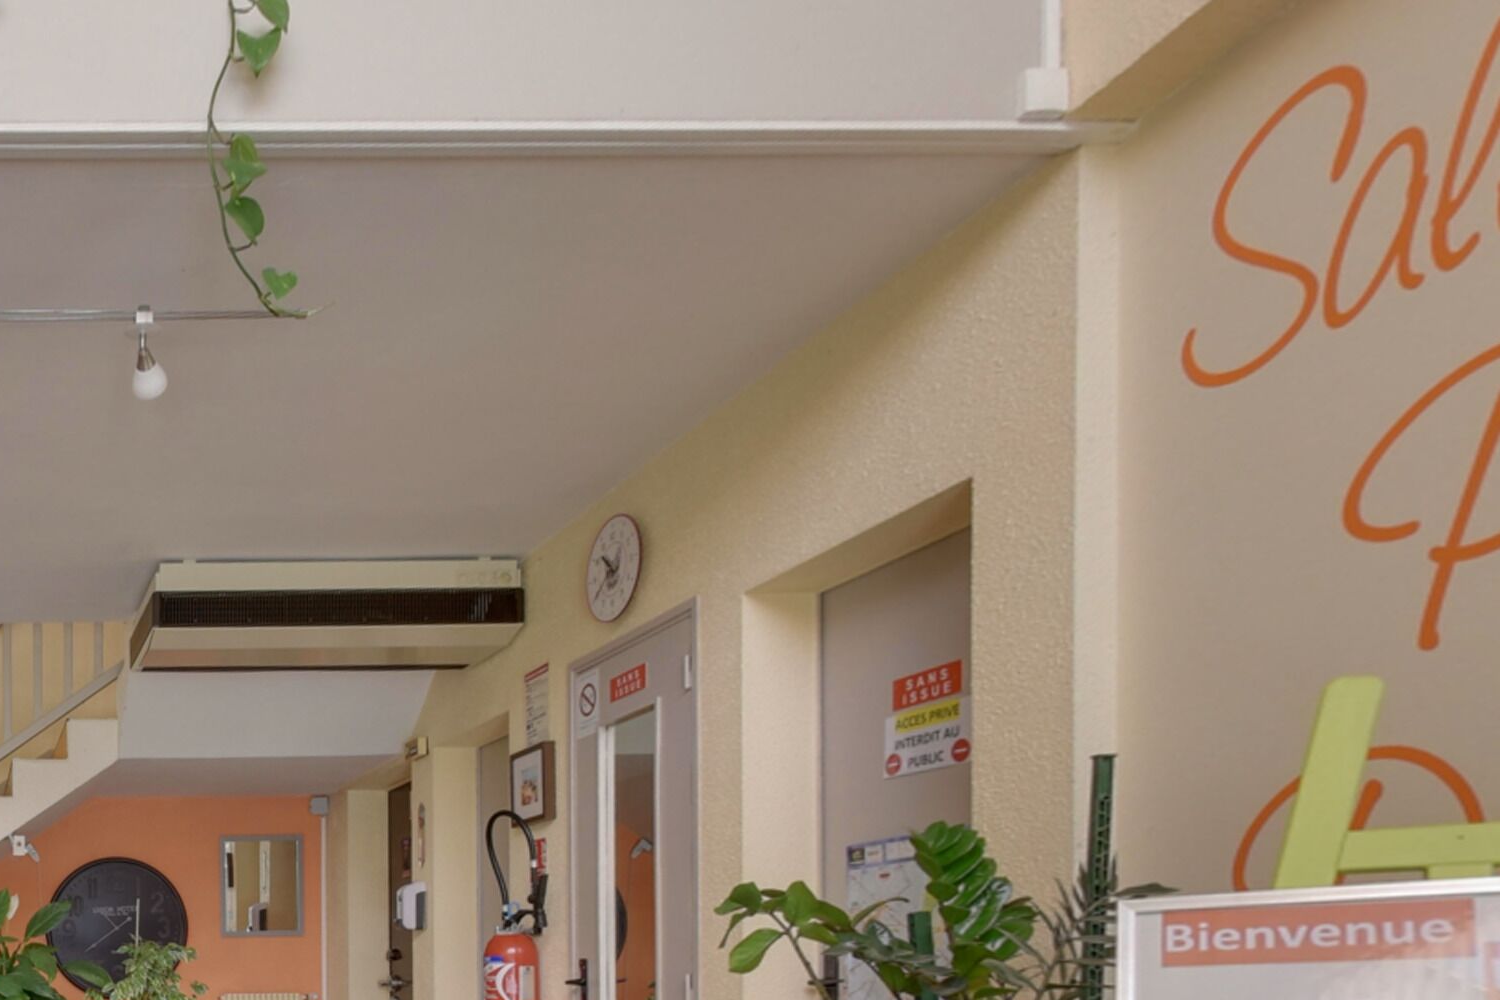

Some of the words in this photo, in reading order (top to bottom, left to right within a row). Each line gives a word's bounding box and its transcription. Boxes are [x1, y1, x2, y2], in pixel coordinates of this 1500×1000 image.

[1181, 16, 1500, 388] Sal
[905, 667, 949, 691] SANS
[901, 680, 954, 706] ISSUE
[894, 730, 941, 752] INTERDIT
[943, 725, 962, 740] AU
[907, 750, 946, 769] PUBLIC
[1164, 917, 1454, 953] Bienvenue
